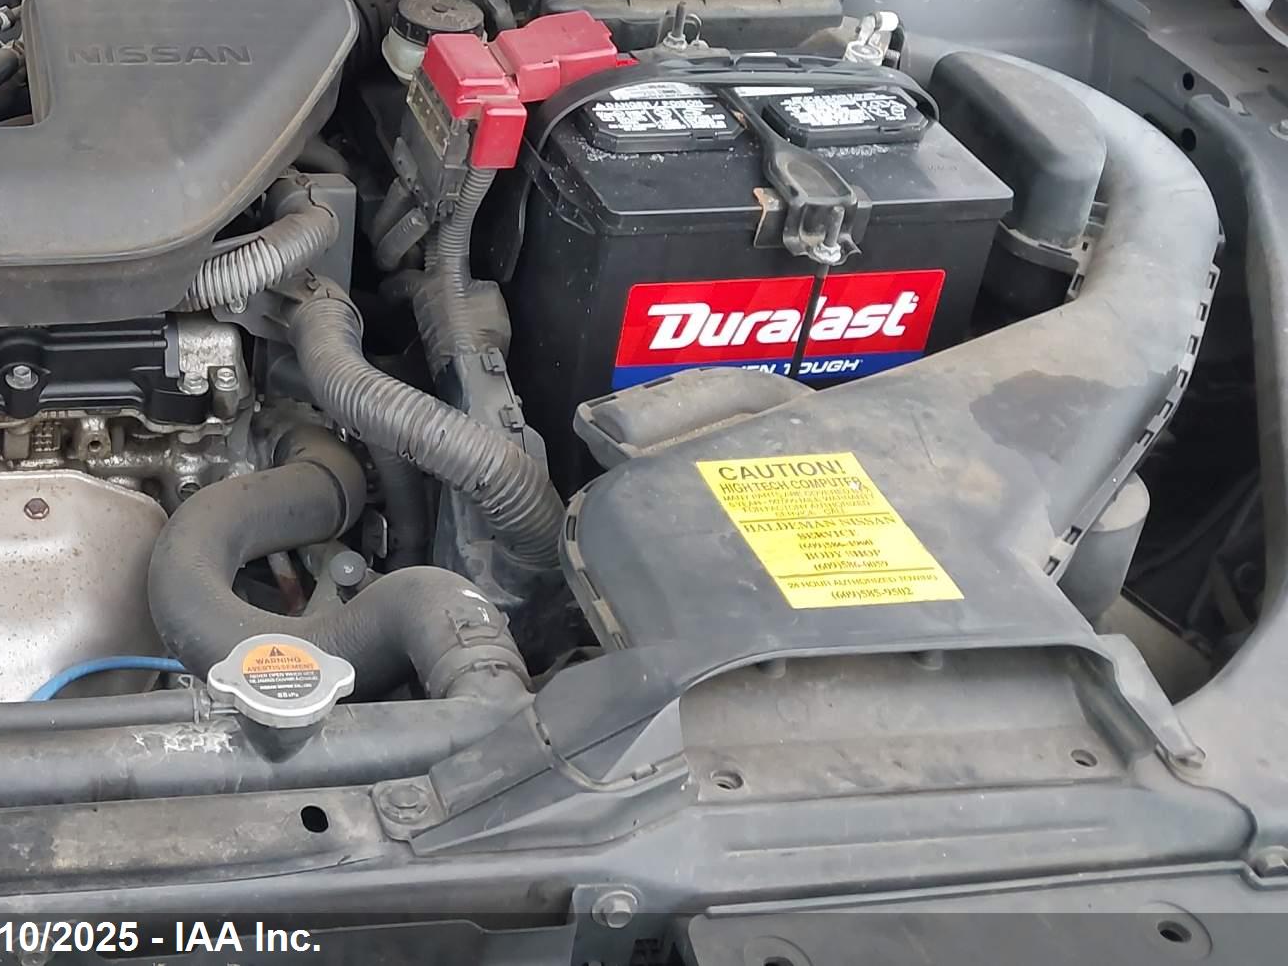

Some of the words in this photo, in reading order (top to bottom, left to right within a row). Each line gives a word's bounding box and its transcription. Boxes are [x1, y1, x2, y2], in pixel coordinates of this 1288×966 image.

[67, 45, 253, 66] NISSAN
[648, 290, 916, 350] Duralast
[718, 460, 846, 481] CAUTION!
[720, 482, 753, 494] HIGH
[752, 480, 790, 491] TECH
[743, 519, 837, 533] HALDEMAN
[839, 516, 897, 527] NISSAN
[804, 550, 842, 560] BODY
[256, 657, 301, 665] WARNING
